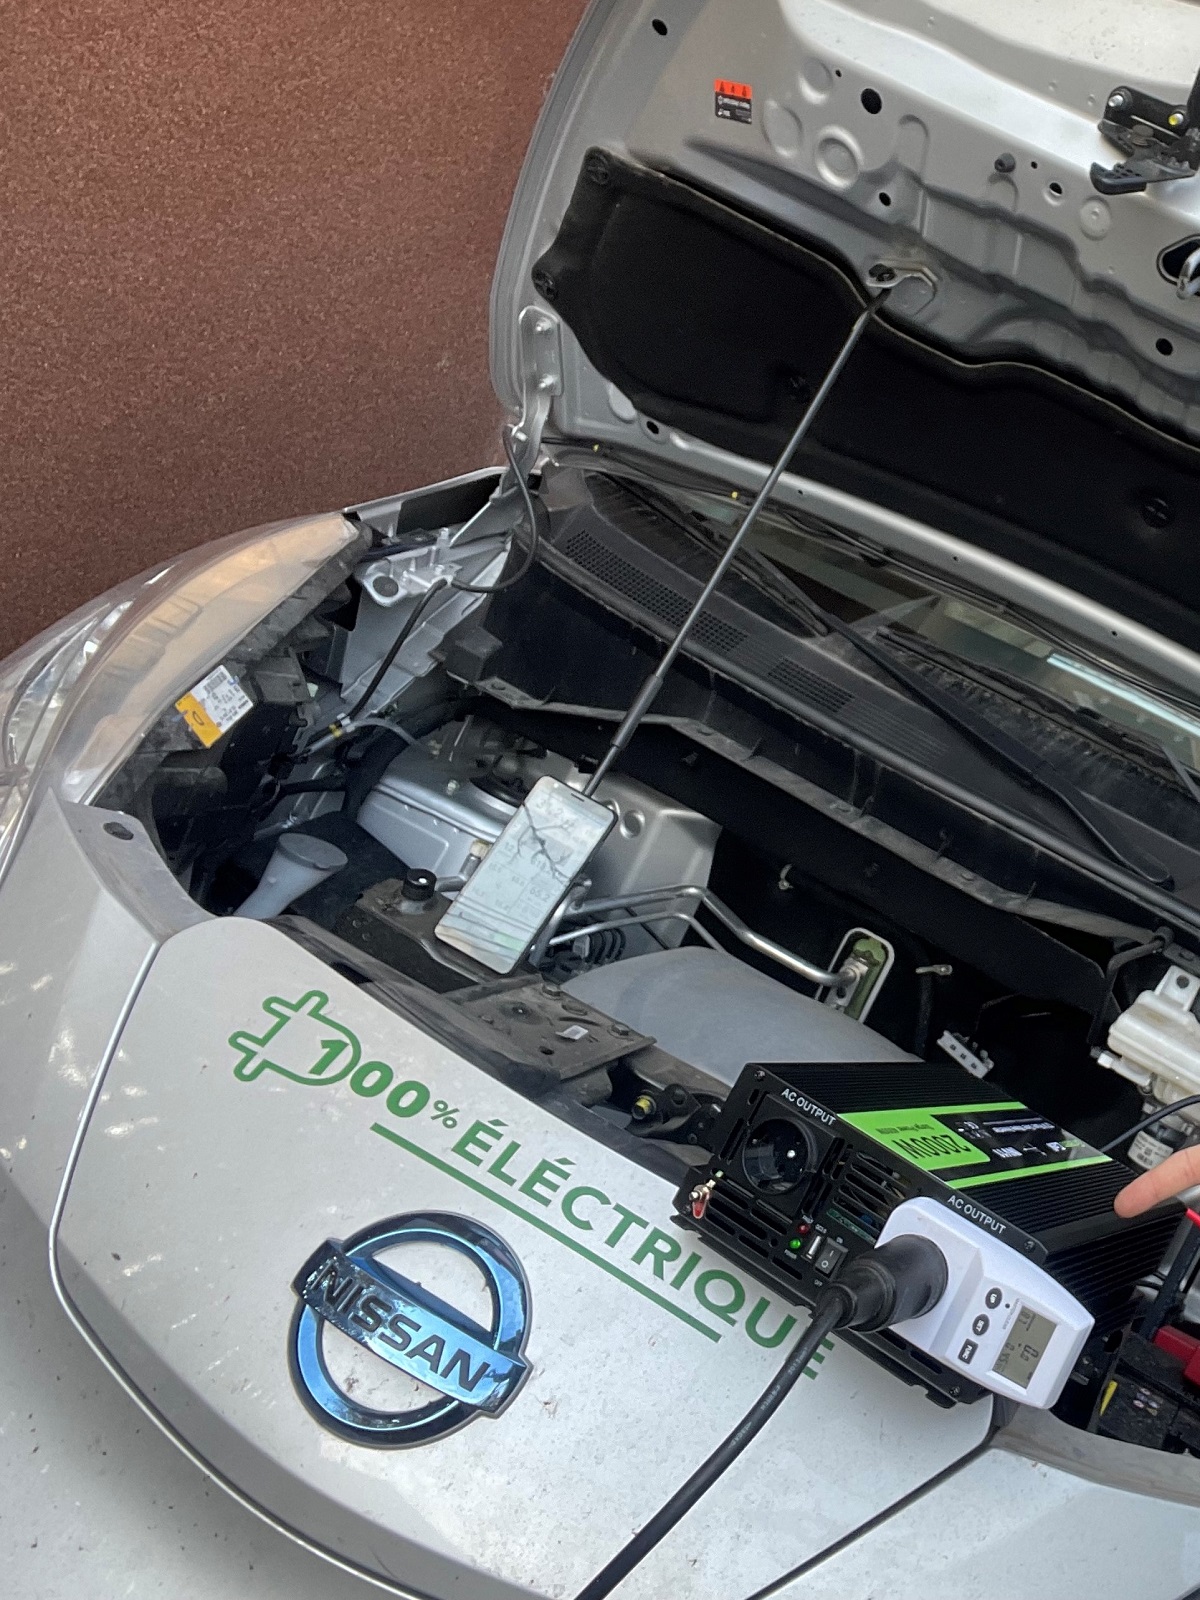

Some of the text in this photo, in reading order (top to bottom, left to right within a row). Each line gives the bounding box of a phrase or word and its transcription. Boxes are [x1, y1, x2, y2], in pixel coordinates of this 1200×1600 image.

[308, 1039, 460, 1129] 100%
[781, 1088, 836, 1126] AC OUTPUT
[891, 1134, 972, 1159] 2000W
[947, 1195, 1006, 1234] AC OUTPUT
[990, 1293, 998, 1304] UP
[311, 1262, 491, 1392] NISSAN
[976, 1319, 985, 1332] SET
[962, 1344, 973, 1360] FUNC
